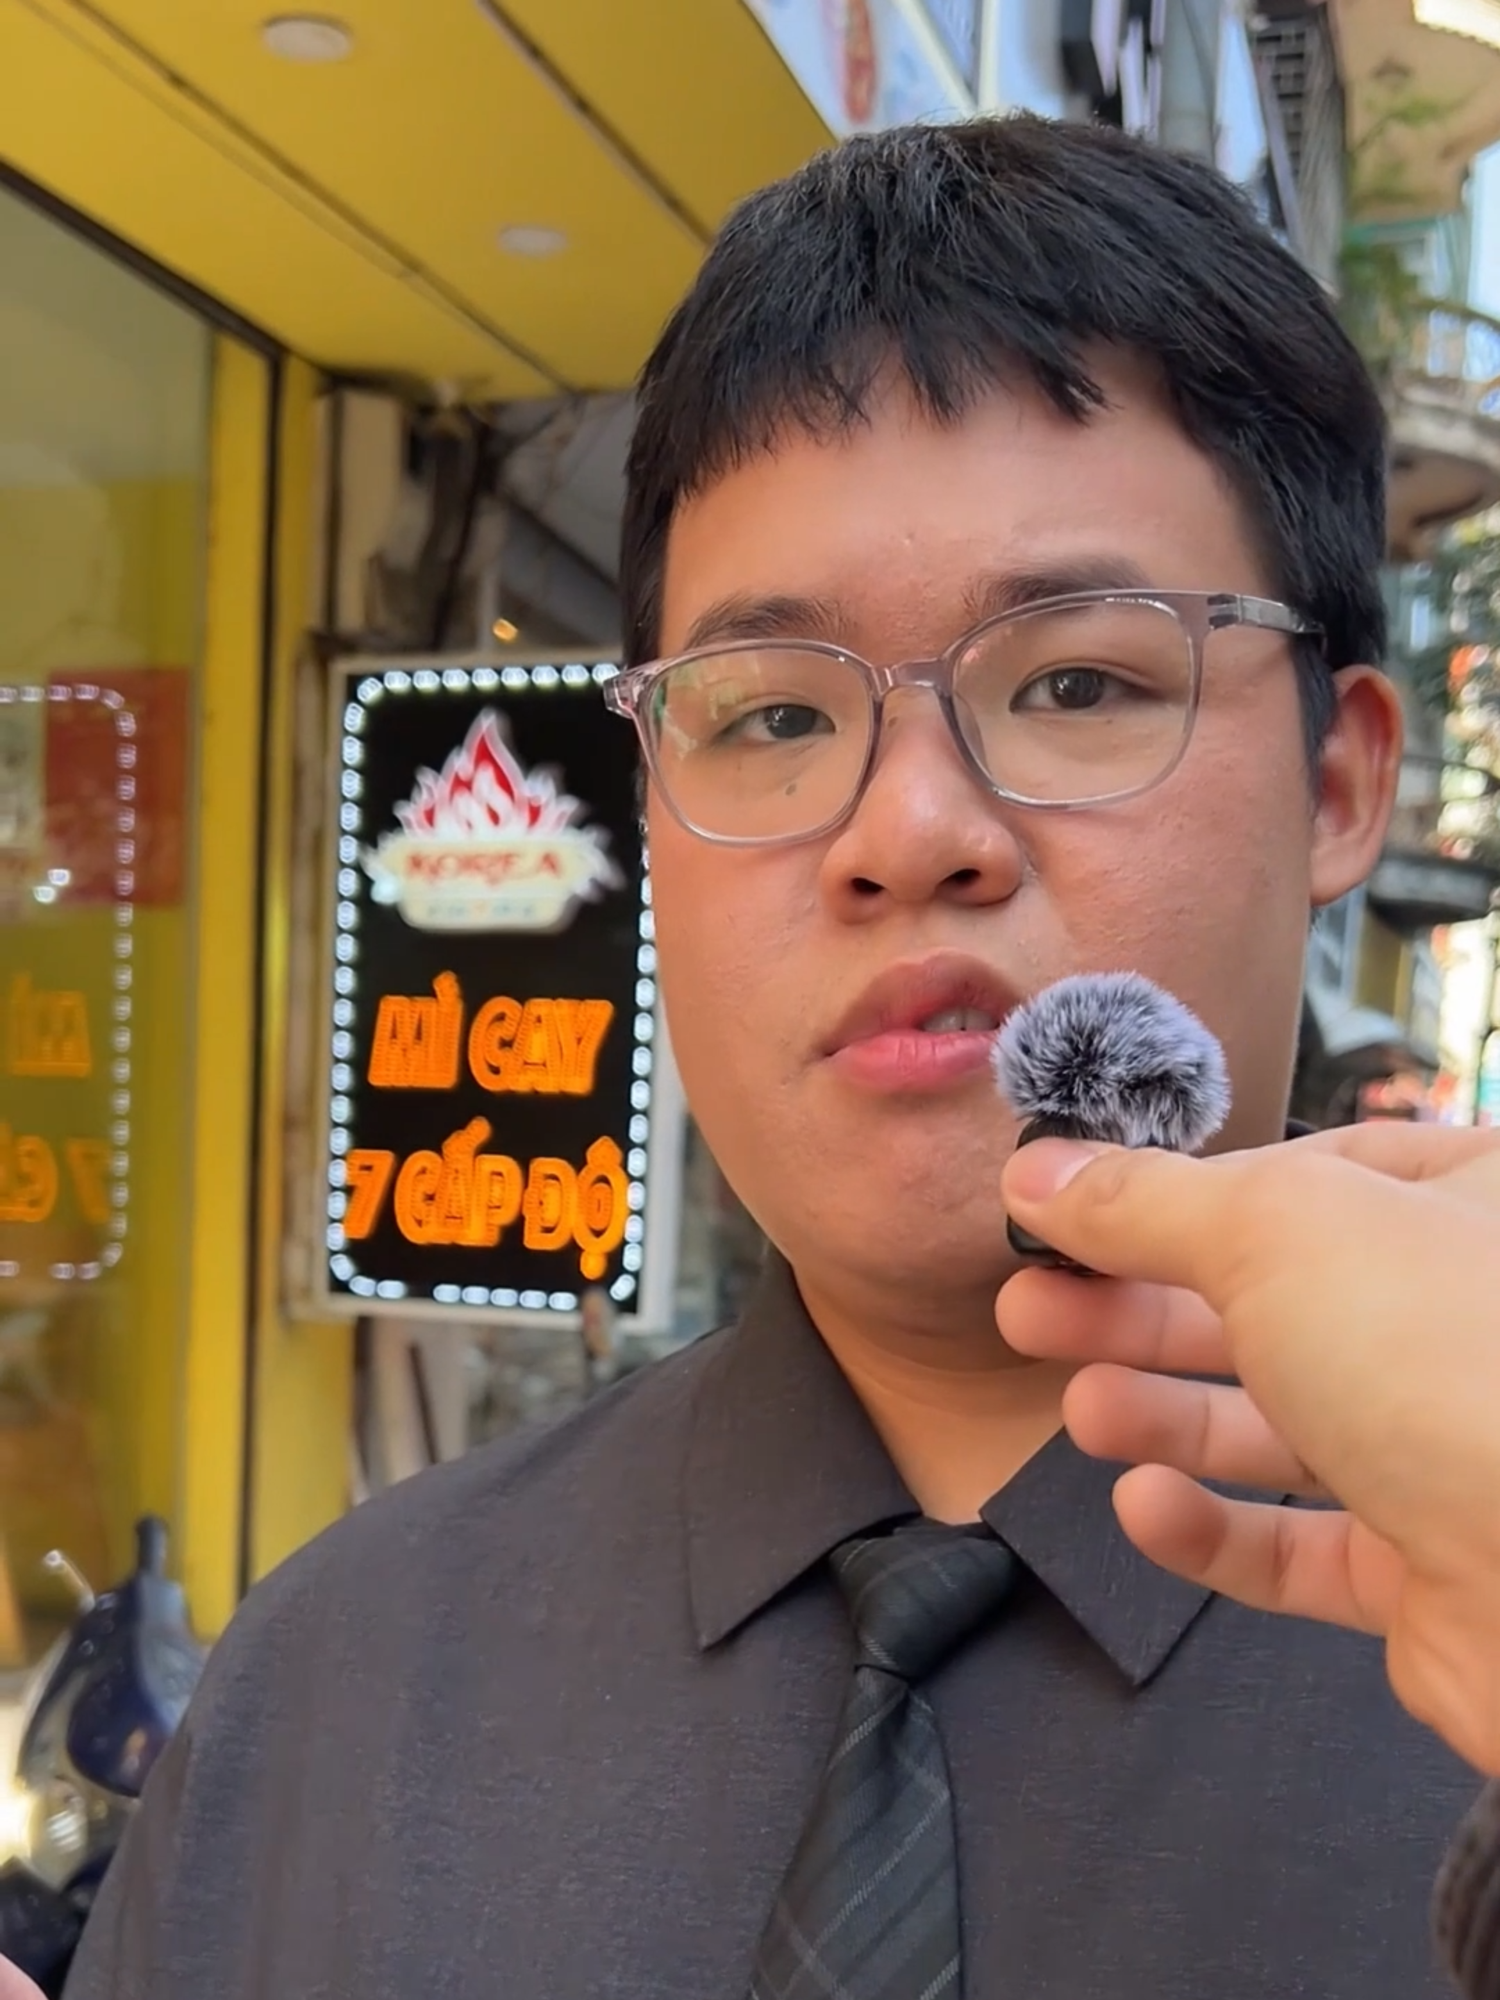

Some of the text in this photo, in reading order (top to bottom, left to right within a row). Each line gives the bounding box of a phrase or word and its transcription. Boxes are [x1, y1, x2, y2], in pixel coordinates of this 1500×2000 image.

[367, 969, 614, 1095] MÌ CAY
[343, 1115, 629, 1281] 7 CẤP ĐỘ
